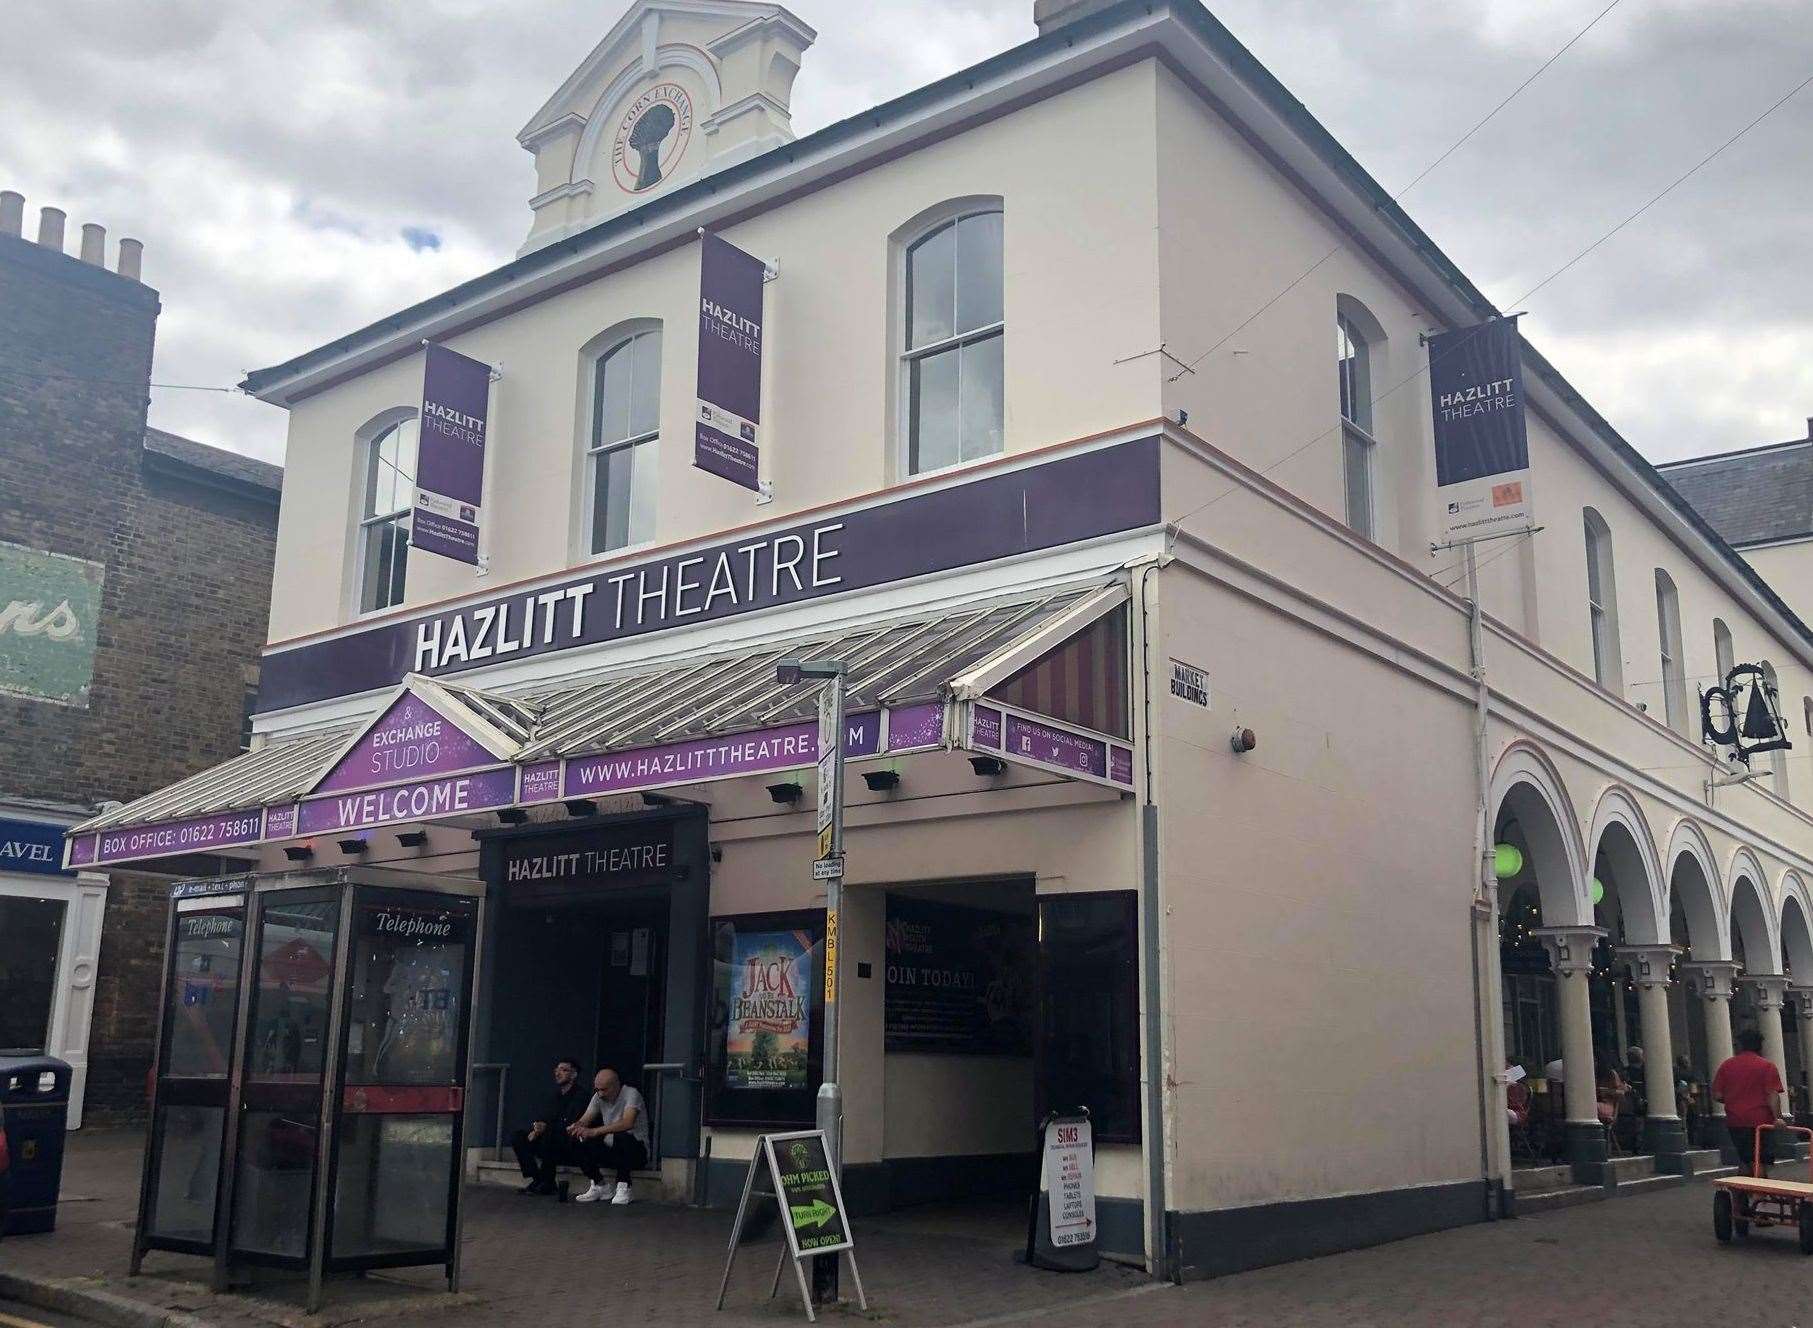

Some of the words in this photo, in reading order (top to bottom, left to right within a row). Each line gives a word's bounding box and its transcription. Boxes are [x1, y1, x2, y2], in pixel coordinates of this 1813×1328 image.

[702, 298, 760, 338] HAZLITT
[701, 315, 760, 356] THEATRE
[1439, 378, 1514, 407] HAZLITT
[425, 400, 484, 432] HAZLITT
[1441, 394, 1516, 422] THEATRE
[424, 415, 484, 447] THEATRE
[415, 583, 593, 672] HAZLITT
[608, 523, 844, 629] THEATRE
[1174, 664, 1204, 689] MARKET
[1171, 678, 1207, 707] BUILDINGS
[404, 706, 412, 719] &
[373, 720, 442, 748] EXCHANGE
[976, 727, 999, 741] HEATRE
[1017, 722, 1031, 733] FIND
[1033, 728, 1041, 736] US
[1042, 730, 1051, 739] ON
[1052, 733, 1073, 746] SOCIAL
[371, 741, 439, 774] STUDIO
[580, 725, 864, 784] WWW.HAZLITTTHEATRE.M
[524, 769, 559, 783] HAZLITT
[524, 780, 559, 794] THEATRE
[338, 779, 470, 826] WELCOME
[268, 811, 294, 822] HAZLITT
[268, 820, 294, 832] THEATRE
[104, 837, 126, 854] BOX
[131, 830, 176, 850] OFFICE:
[180, 824, 214, 844] 01622
[219, 817, 259, 838] 758611
[0, 841, 53, 862] AVEL
[508, 853, 580, 880] HAZLITT
[585, 844, 667, 873] THEATRE
[187, 917, 234, 937] Telephone
[376, 913, 450, 936] Telephone
[742, 956, 795, 999] JACK
[887, 966, 916, 985] OIN
[731, 996, 807, 1021] BEANSTALK
[1057, 1127, 1078, 1143] SIM3
[801, 1170, 829, 1183] PICKED
